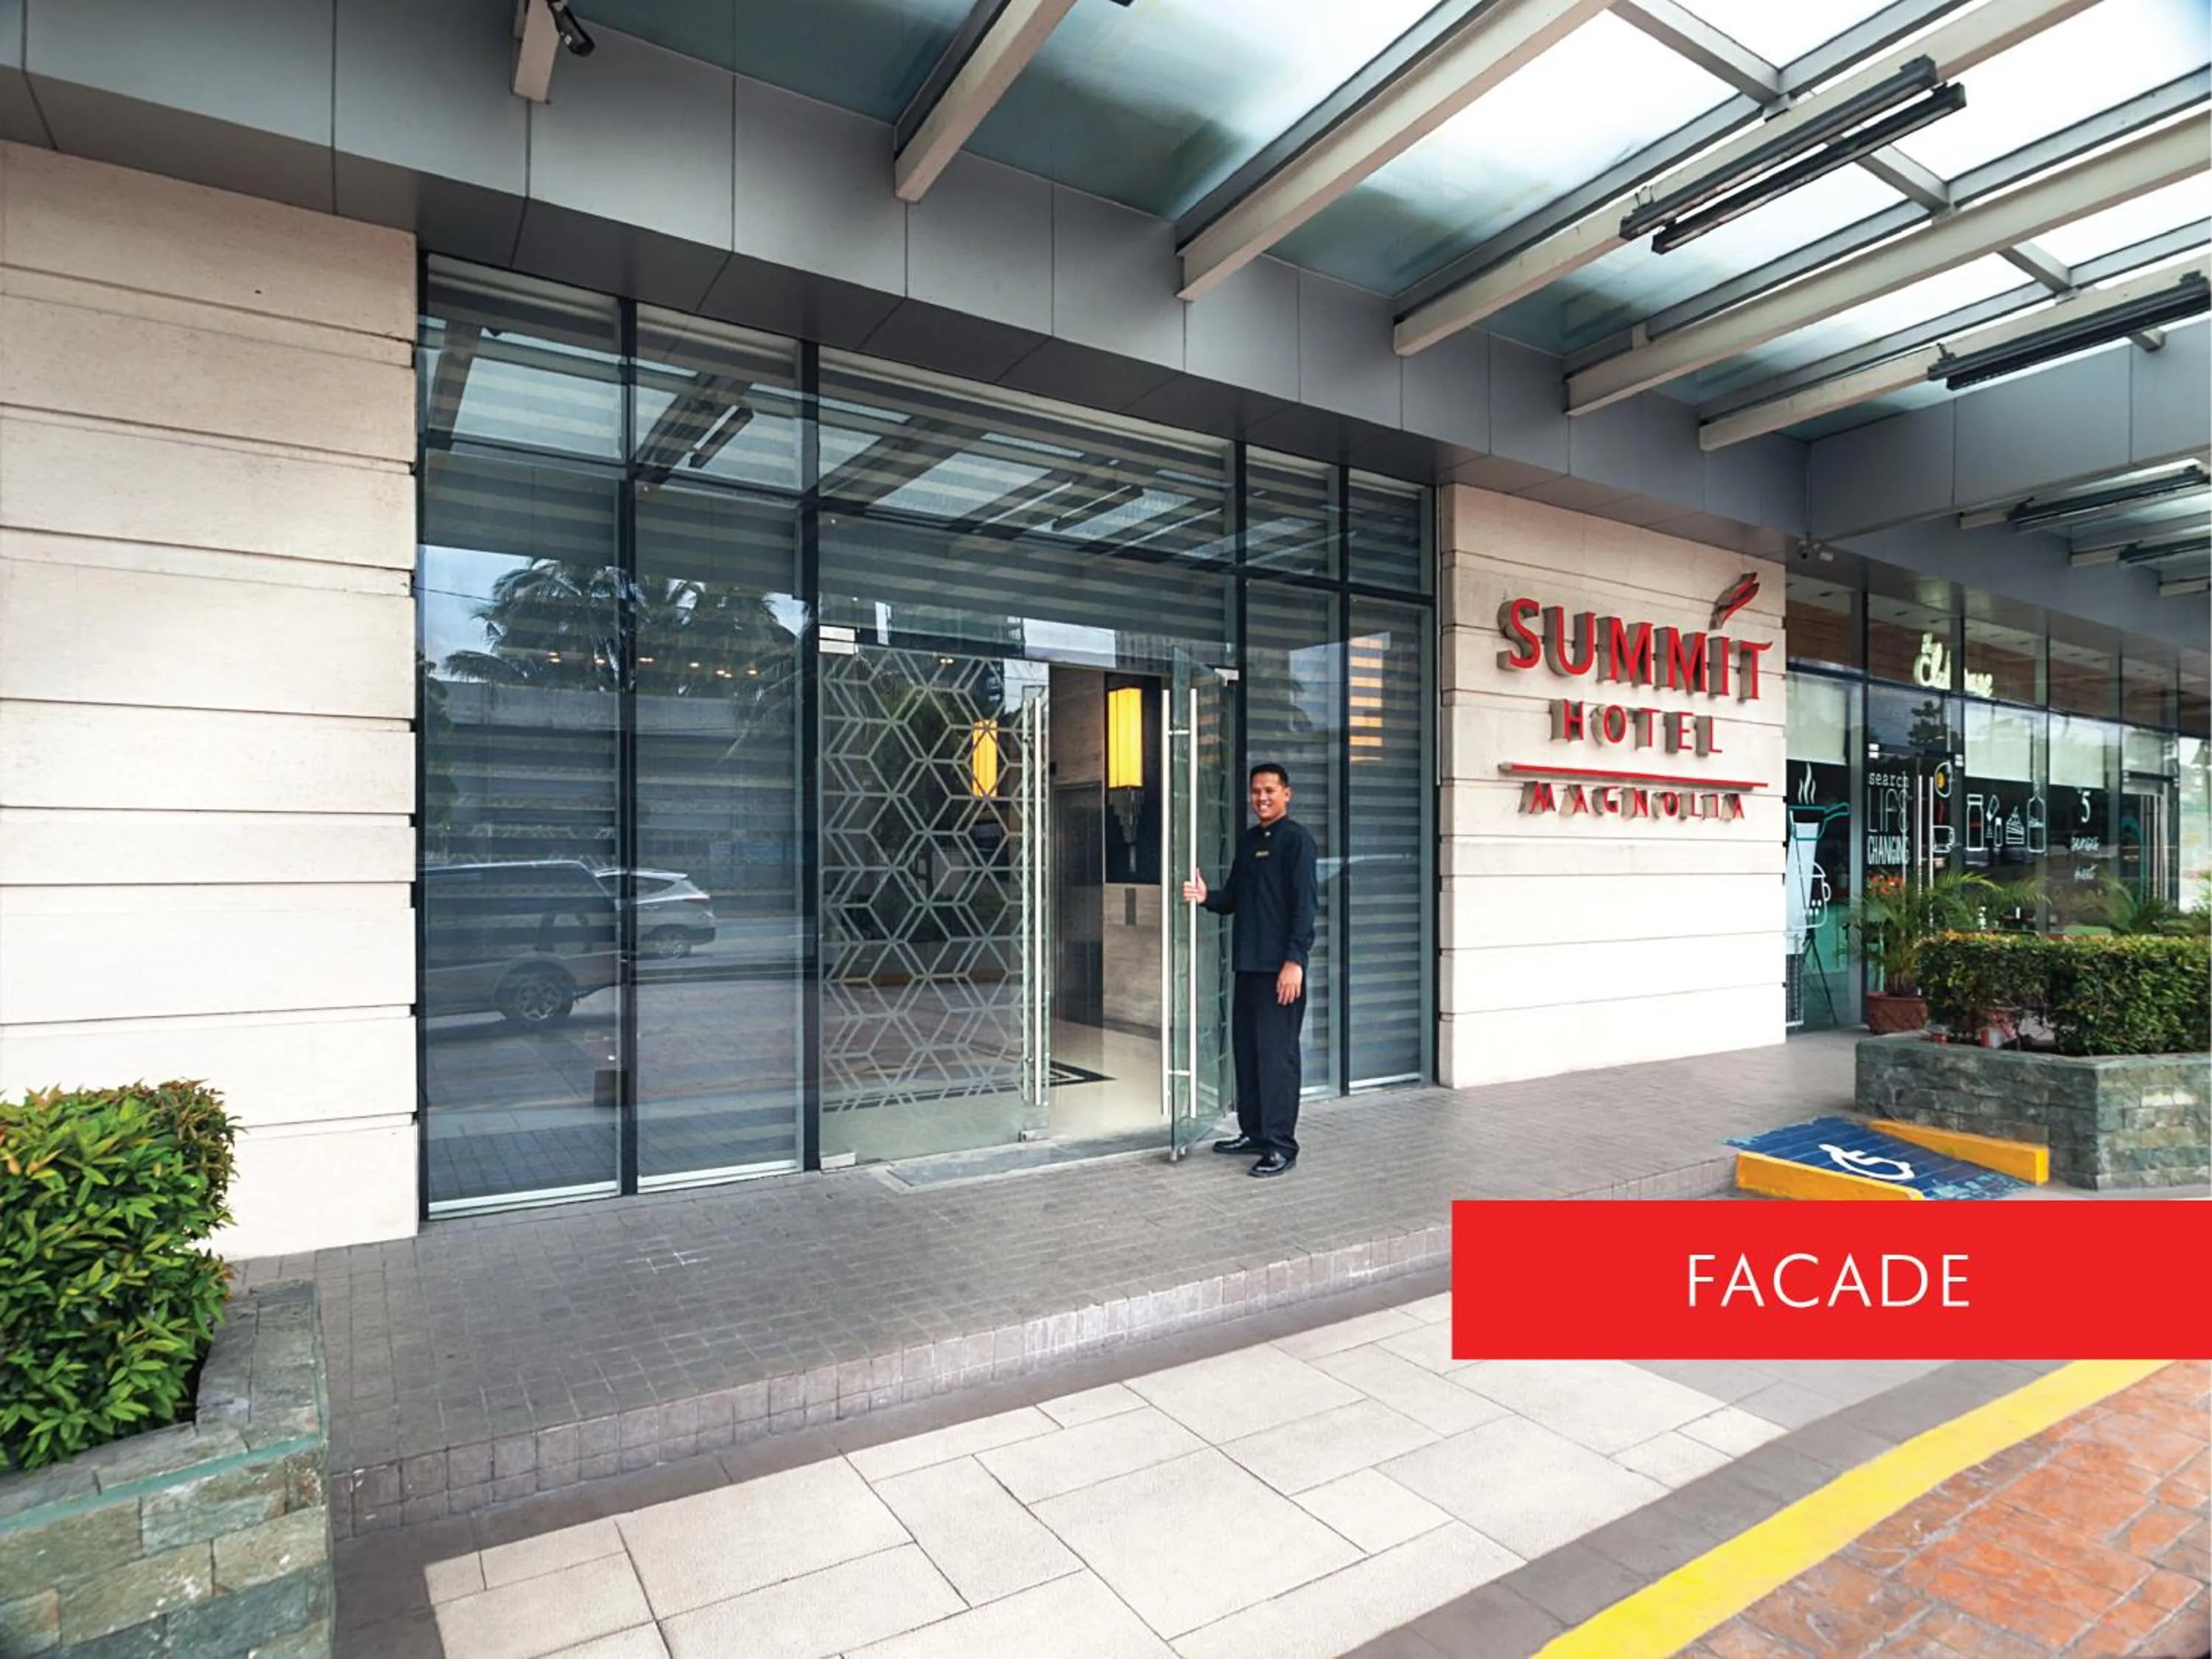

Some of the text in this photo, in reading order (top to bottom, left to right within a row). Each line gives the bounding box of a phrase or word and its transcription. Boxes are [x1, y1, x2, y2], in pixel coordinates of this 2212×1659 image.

[1498, 597, 1773, 702] SUMMIT
[1551, 698, 1723, 755] HOTEL
[1868, 771, 1910, 788] search
[1520, 781, 1745, 820] MAGNOLIA
[1868, 835, 1910, 865] CHANGING
